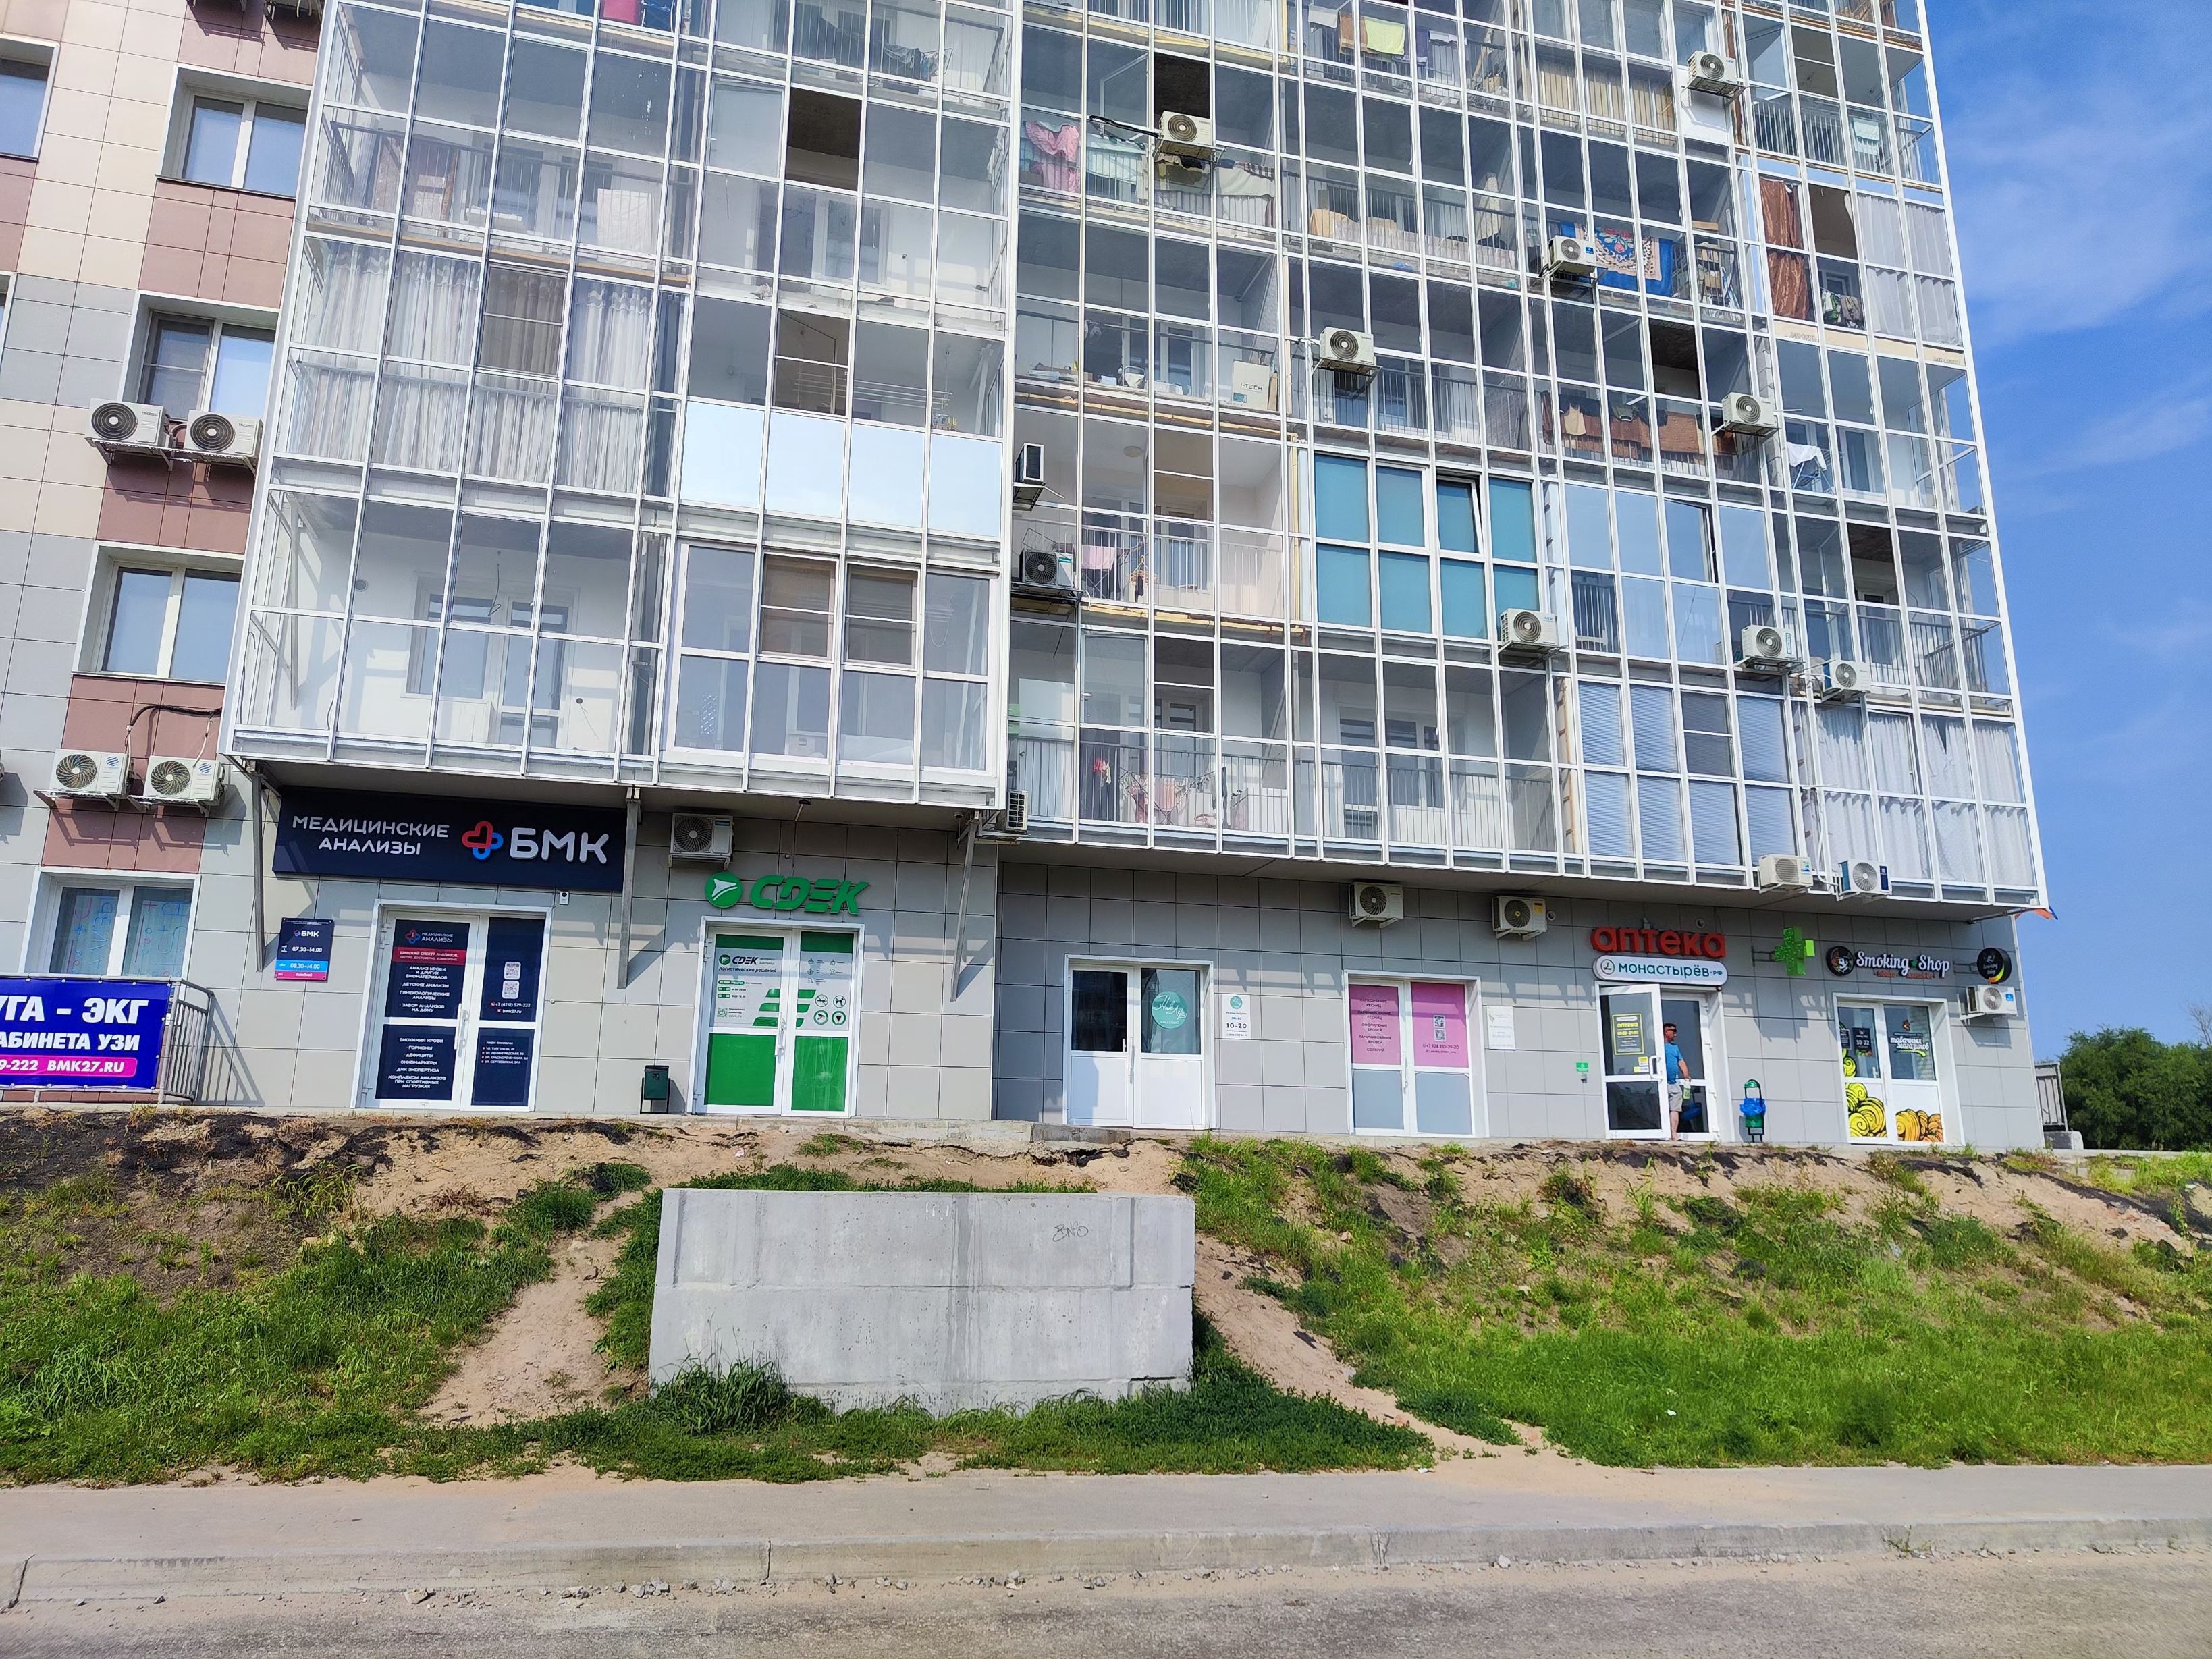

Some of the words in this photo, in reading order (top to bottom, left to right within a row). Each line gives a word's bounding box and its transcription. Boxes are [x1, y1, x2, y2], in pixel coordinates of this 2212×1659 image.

[292, 815, 450, 838] МЕДИЦИНСКИЕ
[318, 837, 421, 856] АНАЛИЗЫ
[510, 827, 609, 865] БМК
[750, 875, 871, 915] CDEK
[1590, 926, 1727, 958] аптека
[732, 956, 759, 965] CDEK
[1856, 951, 1910, 976] Smoking
[1918, 954, 1950, 978] Shop
[82, 997, 149, 1024] ЭКГ
[97, 1033, 140, 1051] УЗИ
[47, 1060, 125, 1073] BMK27.RU
